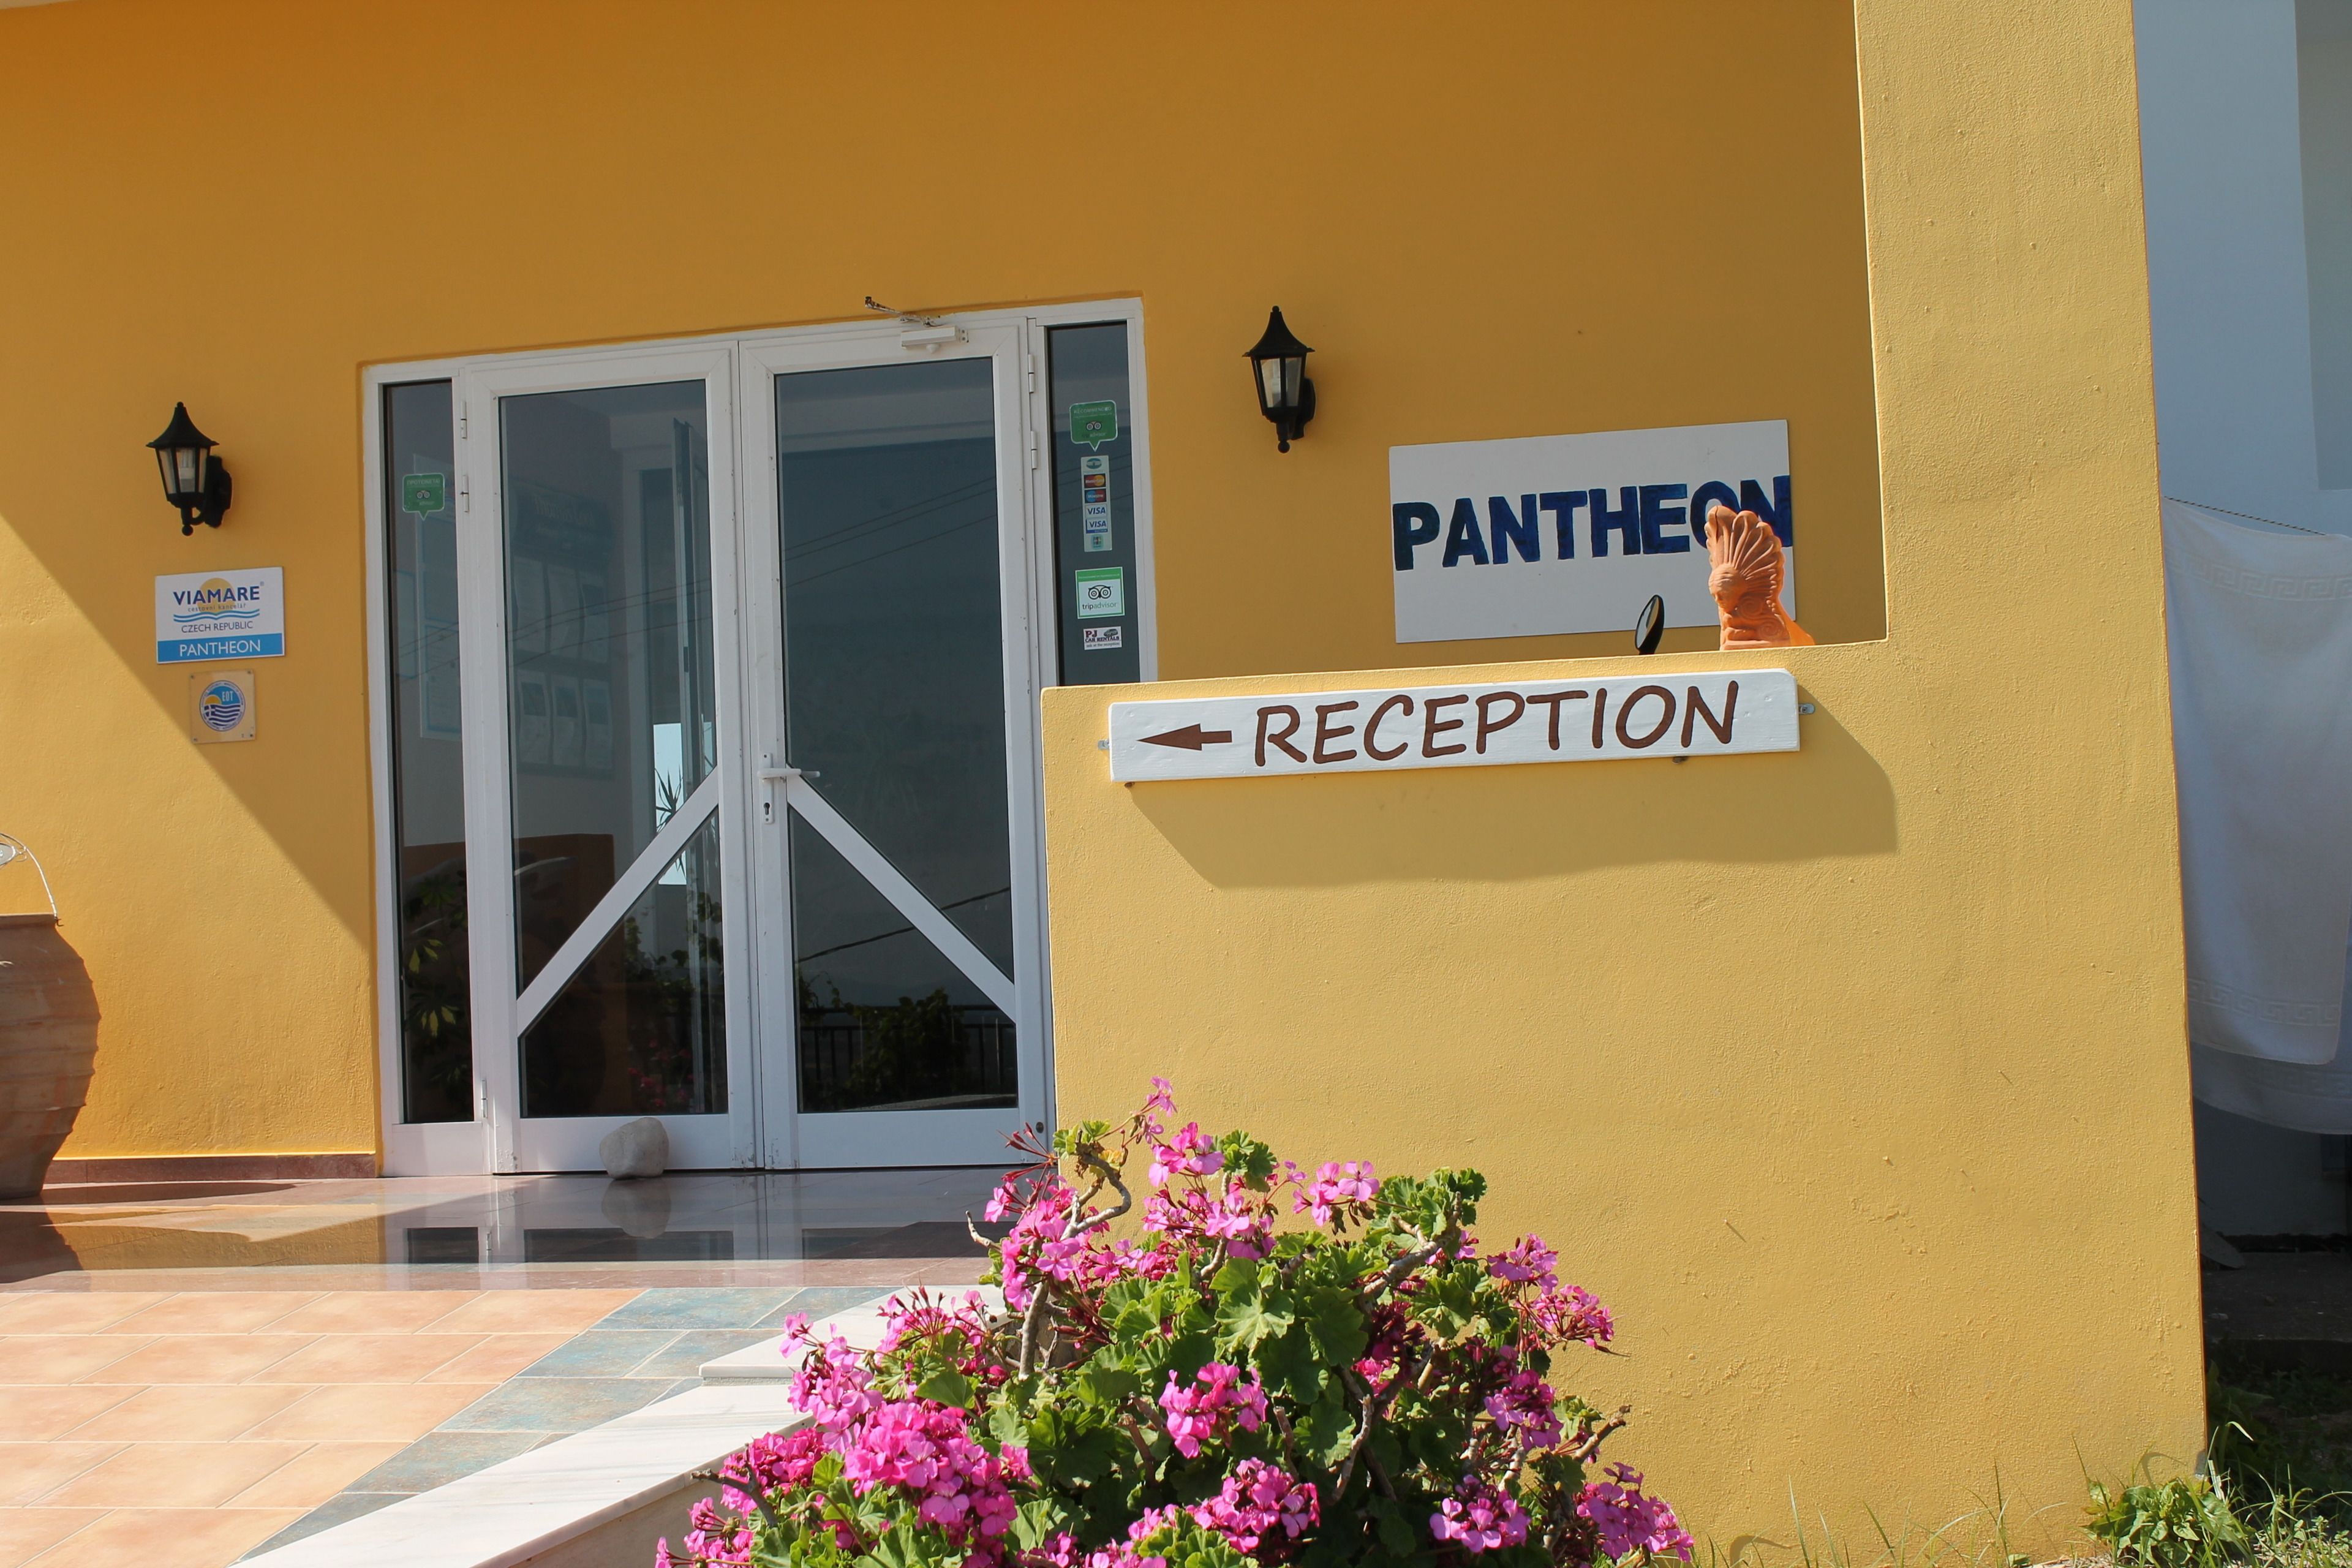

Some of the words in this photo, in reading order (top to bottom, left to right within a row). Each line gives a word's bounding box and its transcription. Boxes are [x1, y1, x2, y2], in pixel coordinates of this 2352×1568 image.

[173, 586, 260, 606] VIAMARE
[1082, 601, 1117, 611] tripadvisor
[181, 624, 211, 633] CZECH
[213, 620, 254, 631] REPUBLIC
[179, 639, 261, 657] PANTHEON
[222, 690, 233, 702] EOT
[1254, 680, 1739, 767] RECEPTION
